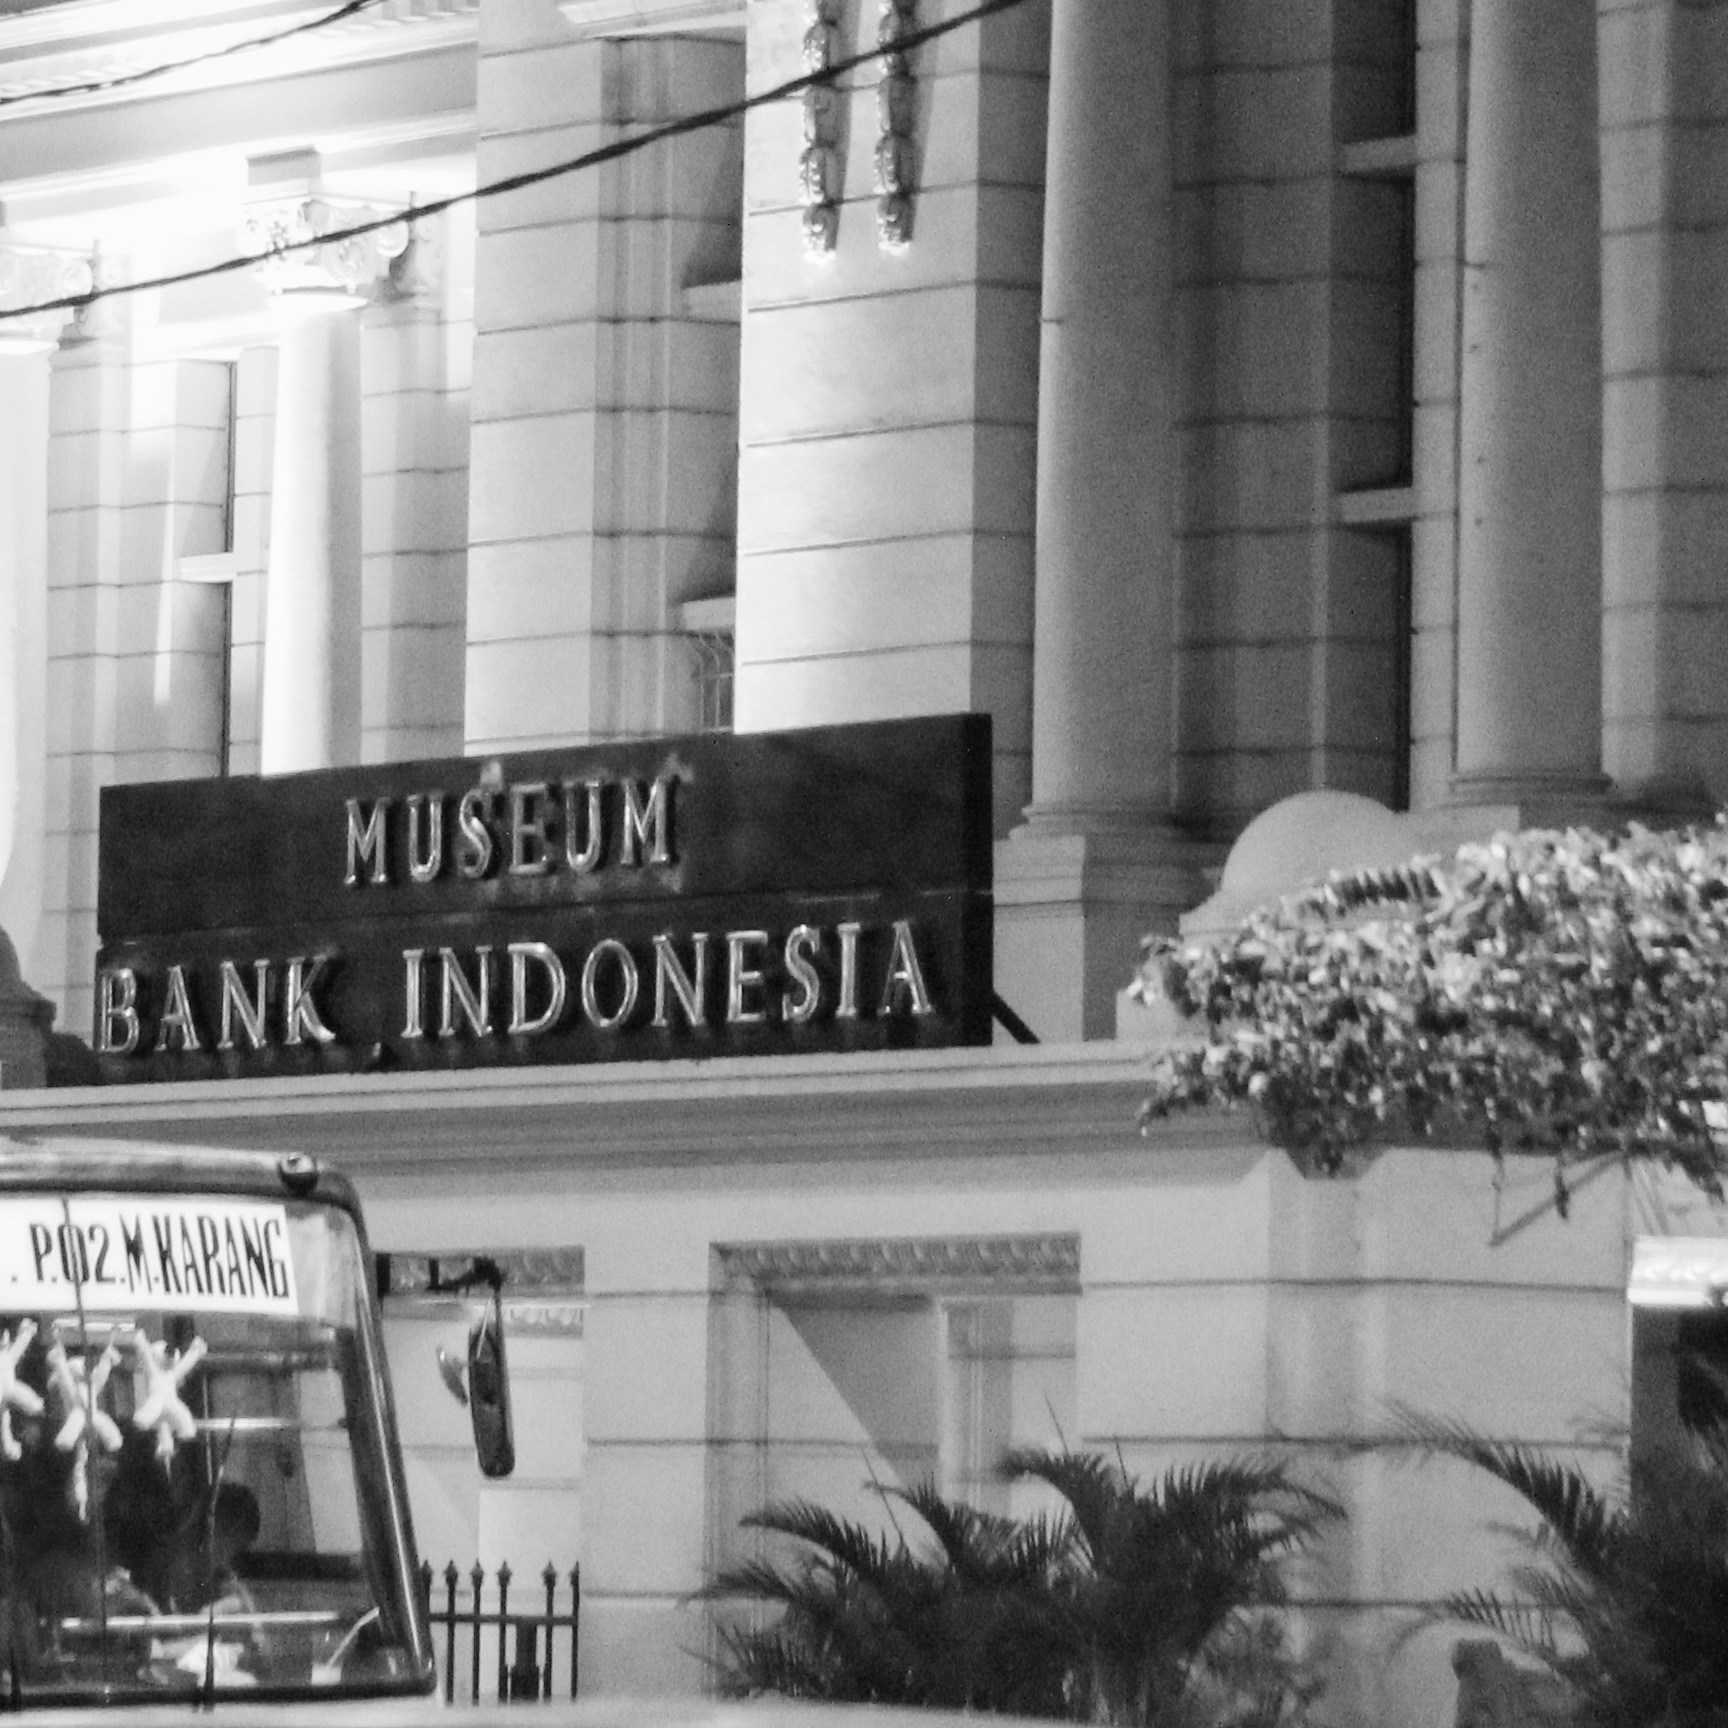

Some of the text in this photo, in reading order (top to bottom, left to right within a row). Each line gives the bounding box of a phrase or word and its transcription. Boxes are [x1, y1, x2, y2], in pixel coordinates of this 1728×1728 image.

[343, 776, 677, 885] MUSEUM
[95, 921, 935, 1055] BANK INDONESIA
